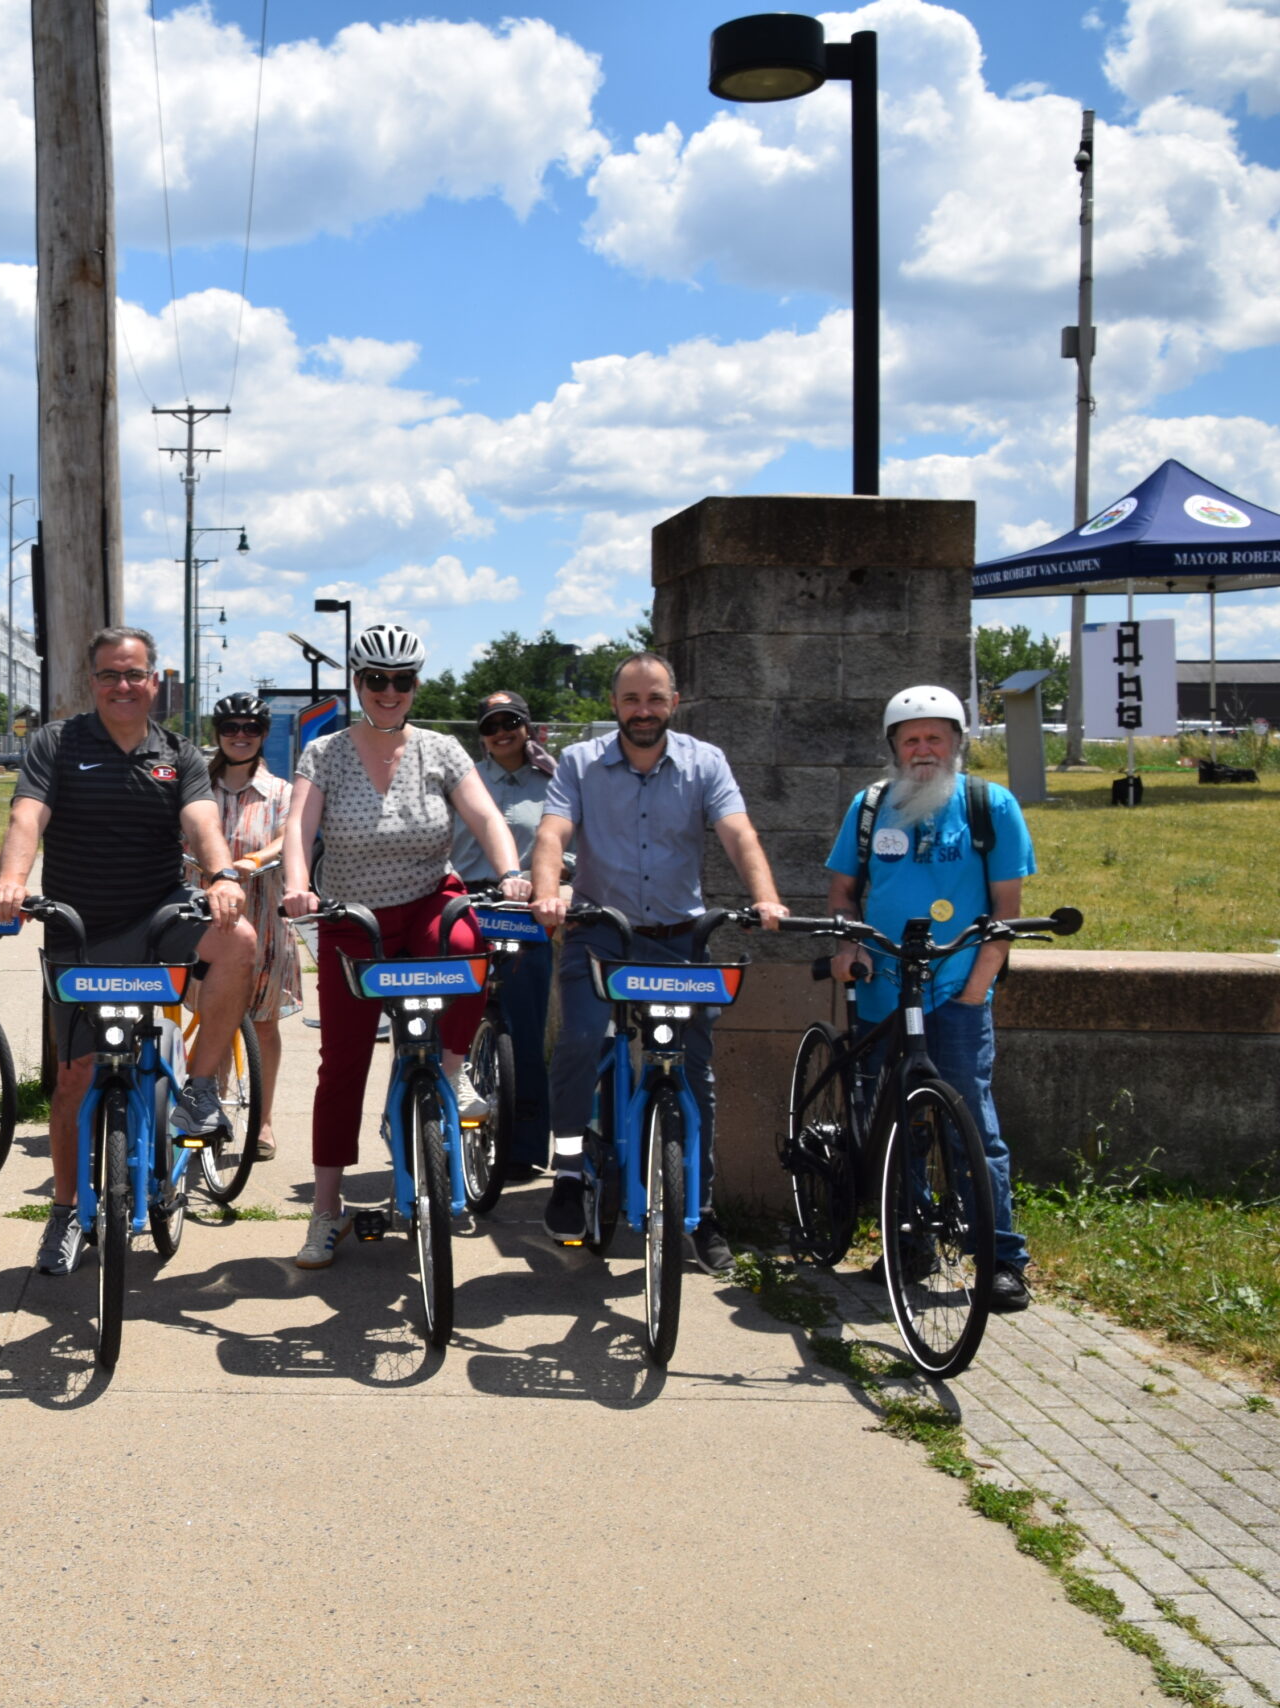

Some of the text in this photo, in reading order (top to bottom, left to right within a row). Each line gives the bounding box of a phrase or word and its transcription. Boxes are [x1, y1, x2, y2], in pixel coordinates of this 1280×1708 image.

[1174, 550, 1280, 566] MAYOR ROBER
[971, 558, 1102, 587] MAYOR ROBERT VAN CAMPEN
[157, 768, 173, 778] E
[476, 917, 538, 934] BLUEbikes
[75, 977, 163, 991] BLUEbikes
[379, 972, 464, 987] BLUEbikes
[627, 976, 716, 992] BLUEbikes
